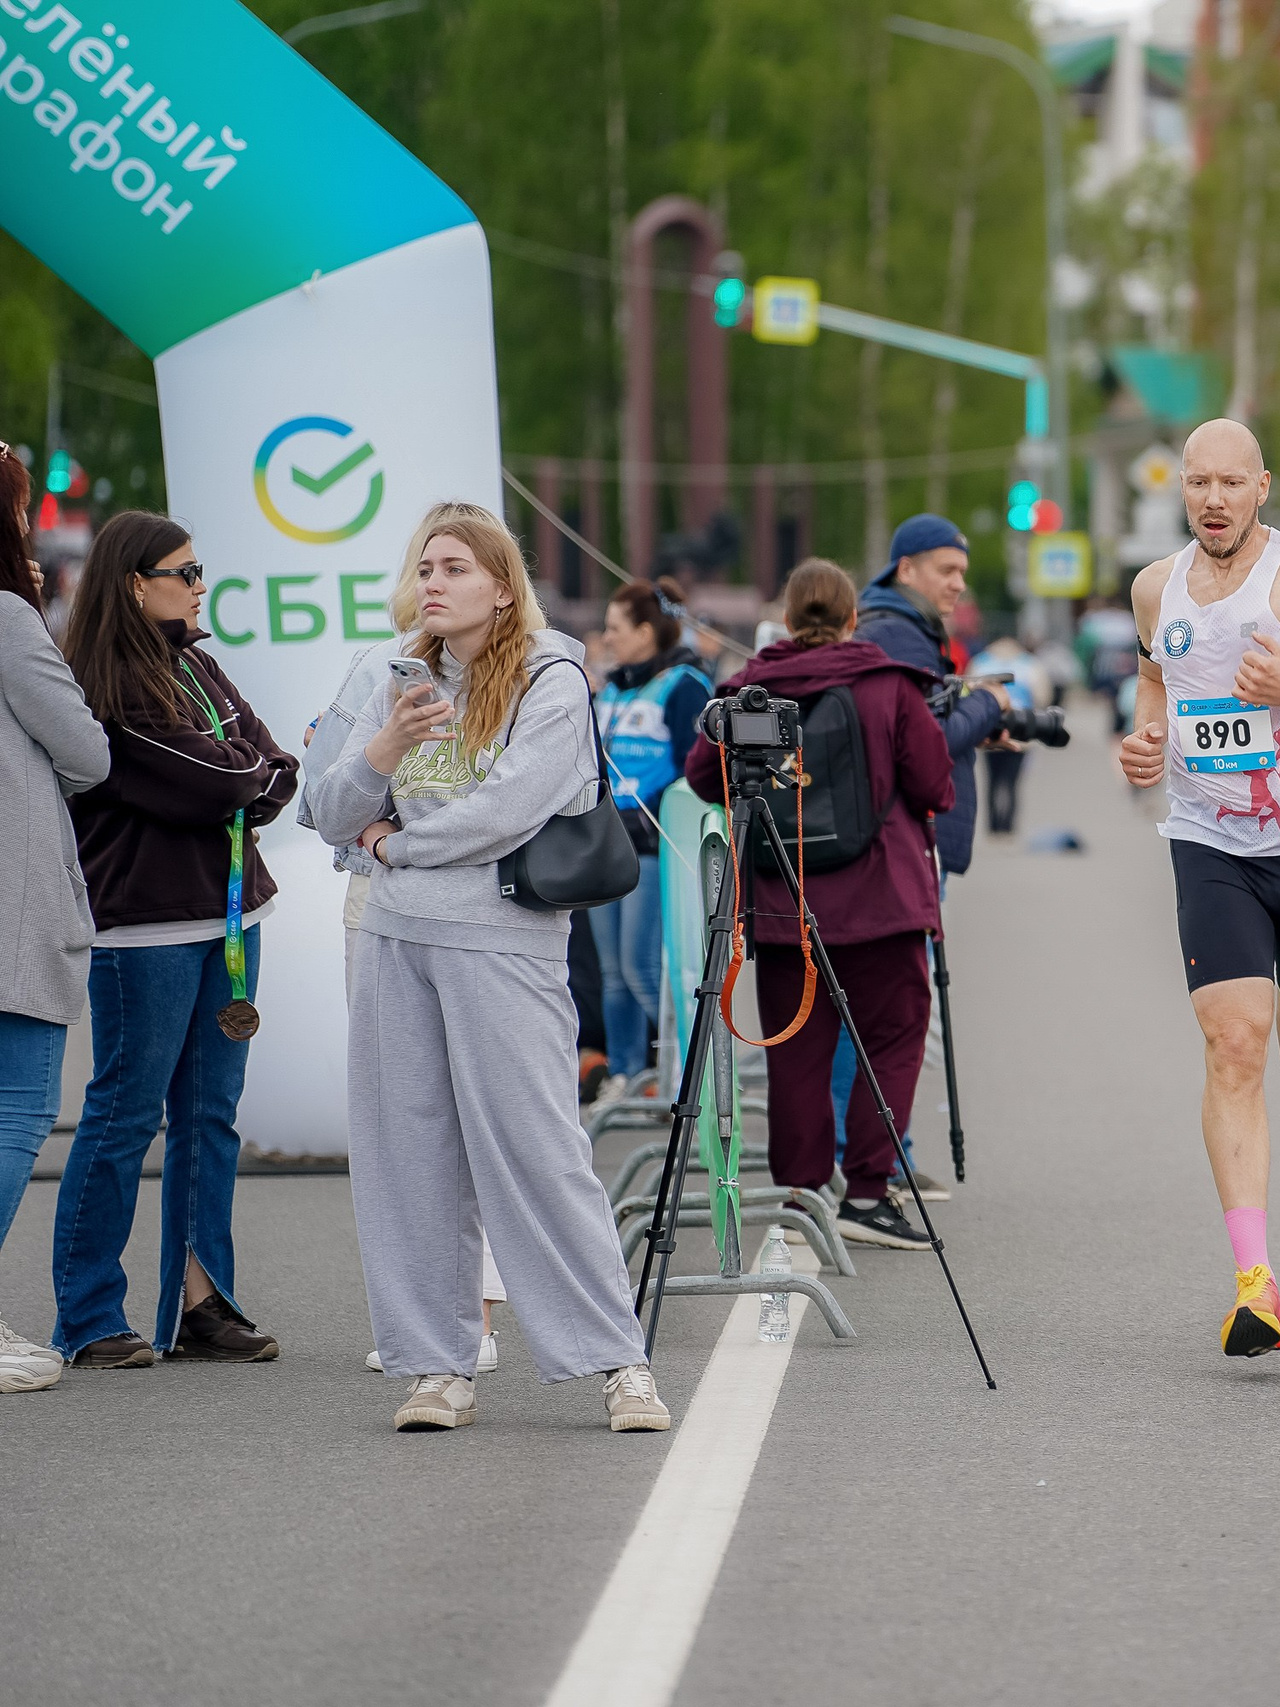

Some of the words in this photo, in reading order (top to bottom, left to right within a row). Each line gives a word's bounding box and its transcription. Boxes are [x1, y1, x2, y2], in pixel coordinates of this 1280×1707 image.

[0, 35, 193, 234] рафон
[209, 573, 396, 645] СБЕ
[1195, 719, 1251, 750] 890
